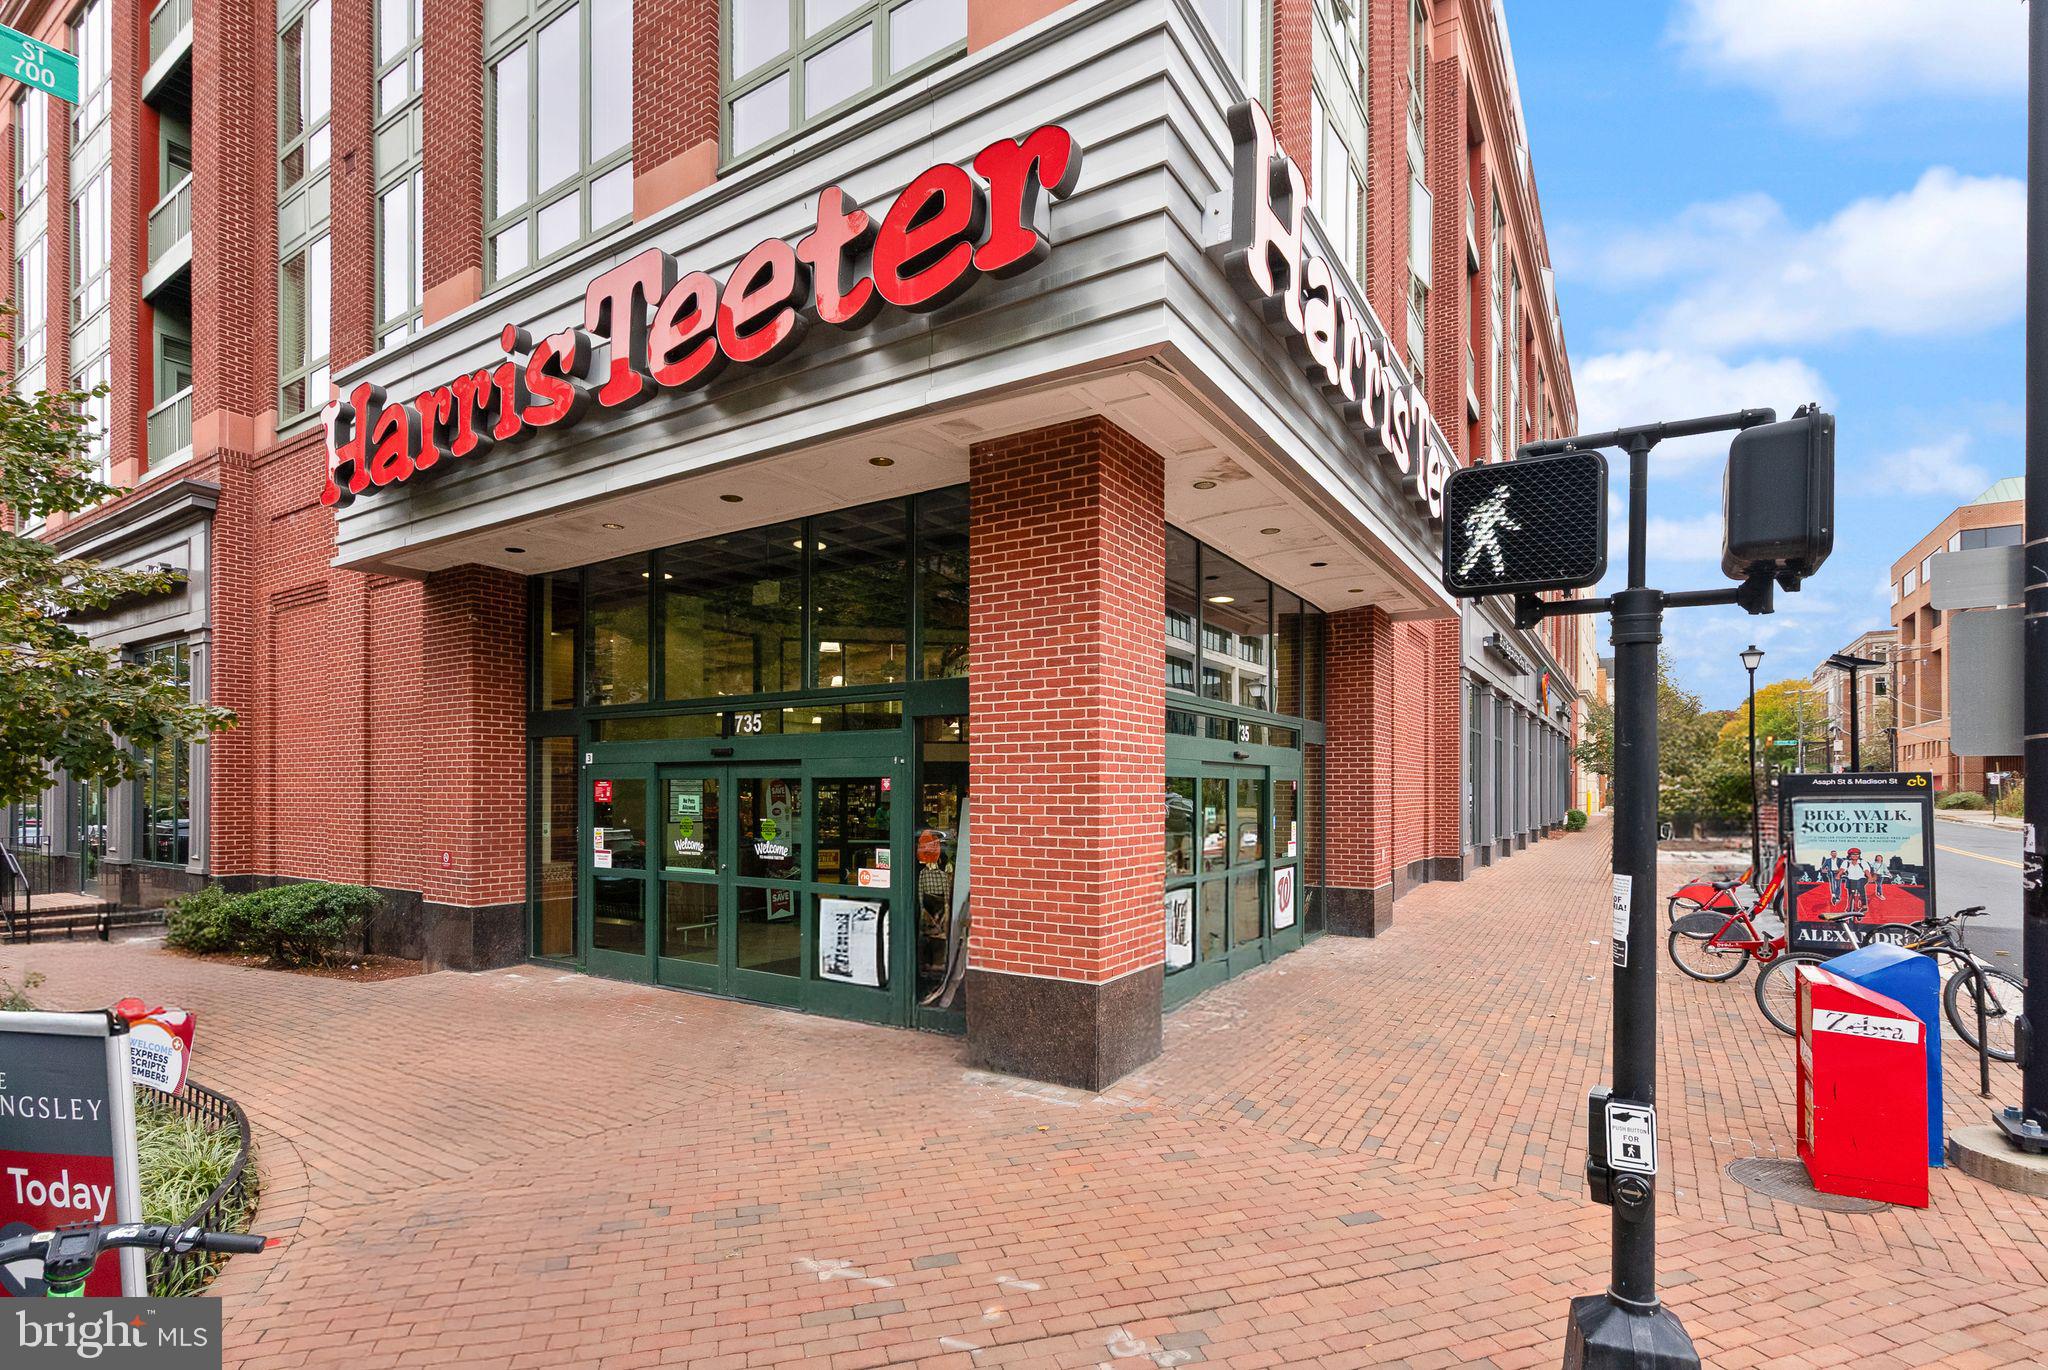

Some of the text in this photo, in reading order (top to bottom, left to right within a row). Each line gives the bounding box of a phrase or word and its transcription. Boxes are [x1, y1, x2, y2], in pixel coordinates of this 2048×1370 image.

[22, 41, 48, 65] ST
[11, 54, 56, 88] 700
[735, 714, 762, 733] 735
[1812, 778, 1836, 786] Asaph
[1855, 777, 1888, 785] Madison
[1889, 777, 1898, 785] St
[1804, 810, 1912, 822] BIKE, WALK,
[1801, 822, 1888, 833] SCOOTER
[674, 838, 704, 853] Welcome
[754, 841, 789, 857] Welcome
[772, 892, 790, 903] SAVE
[1825, 1010, 1906, 1040] Zebra
[130, 1047, 168, 1064] EXPRESS
[130, 1056, 166, 1073] SCRIPTS
[1627, 1126, 1647, 1134] BUTTON
[1623, 1134, 1640, 1143] FOR
[7, 1167, 112, 1222] Today
